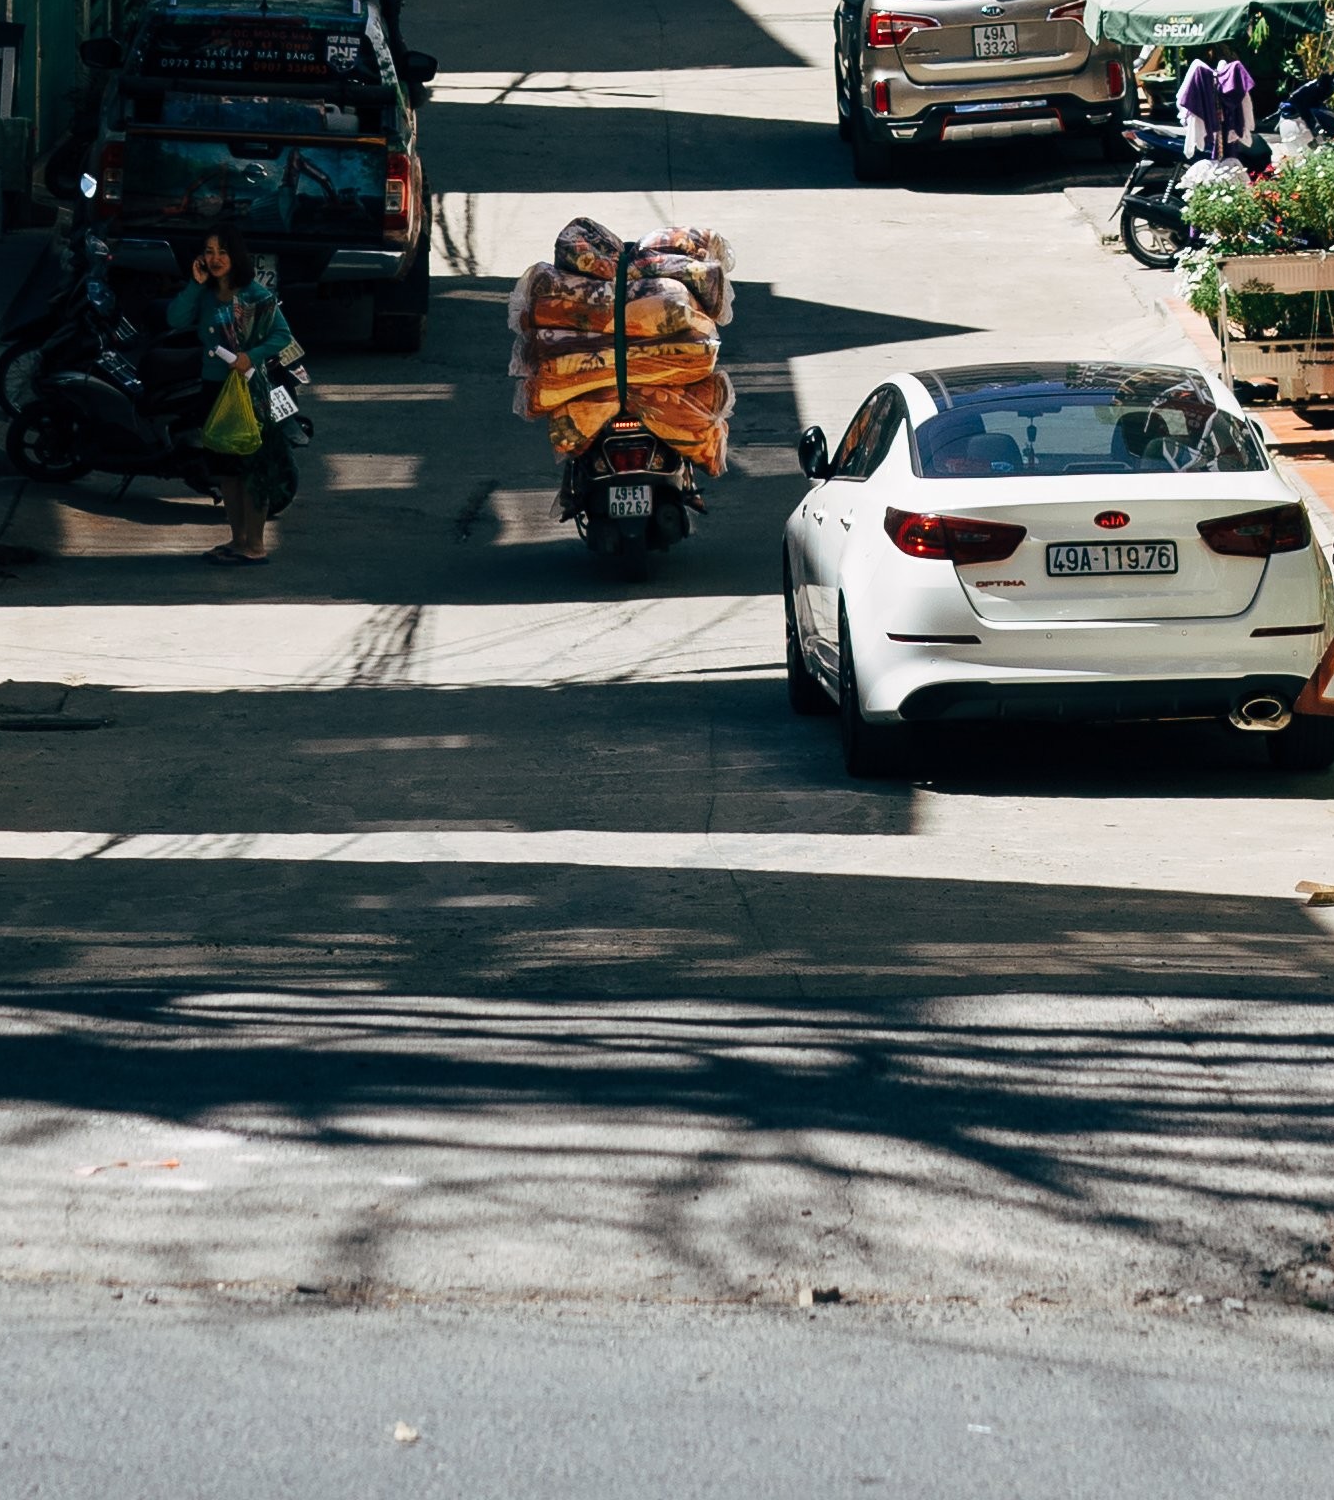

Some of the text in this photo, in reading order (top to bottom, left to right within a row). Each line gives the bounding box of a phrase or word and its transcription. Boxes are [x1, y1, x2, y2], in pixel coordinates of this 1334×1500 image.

[983, 27, 1006, 41] 49A
[1153, 23, 1207, 38] SPECIAL
[976, 40, 1016, 56] 133.23
[1100, 514, 1125, 525] KIA
[1053, 544, 1171, 572] 49A-119.76
[975, 580, 1027, 588] OPTIMA
